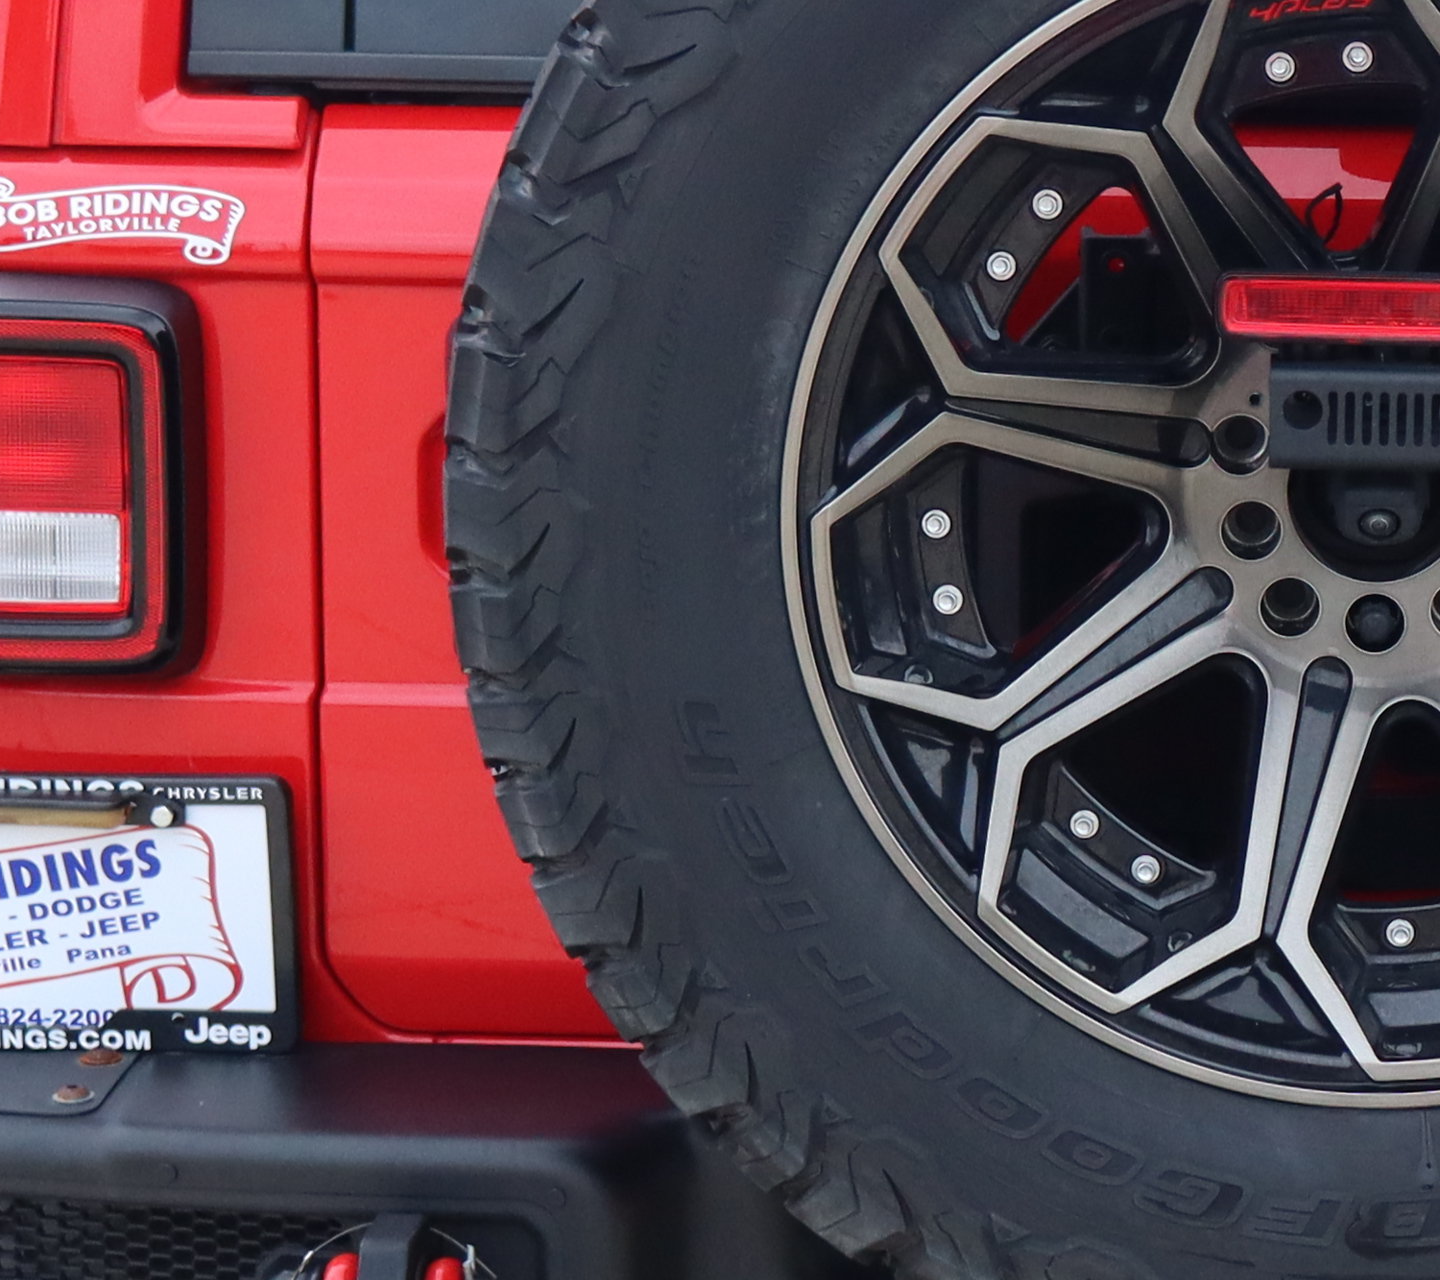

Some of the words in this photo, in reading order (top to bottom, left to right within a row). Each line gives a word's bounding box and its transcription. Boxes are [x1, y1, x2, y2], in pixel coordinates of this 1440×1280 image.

[70, 192, 222, 222] RIDINGS
[23, 217, 181, 241] TAYLORVILLE
[28, 888, 144, 920] DODGE
[80, 911, 161, 939] JEEP
[66, 944, 132, 964] Pana
[184, 1016, 271, 1050] Jeep
